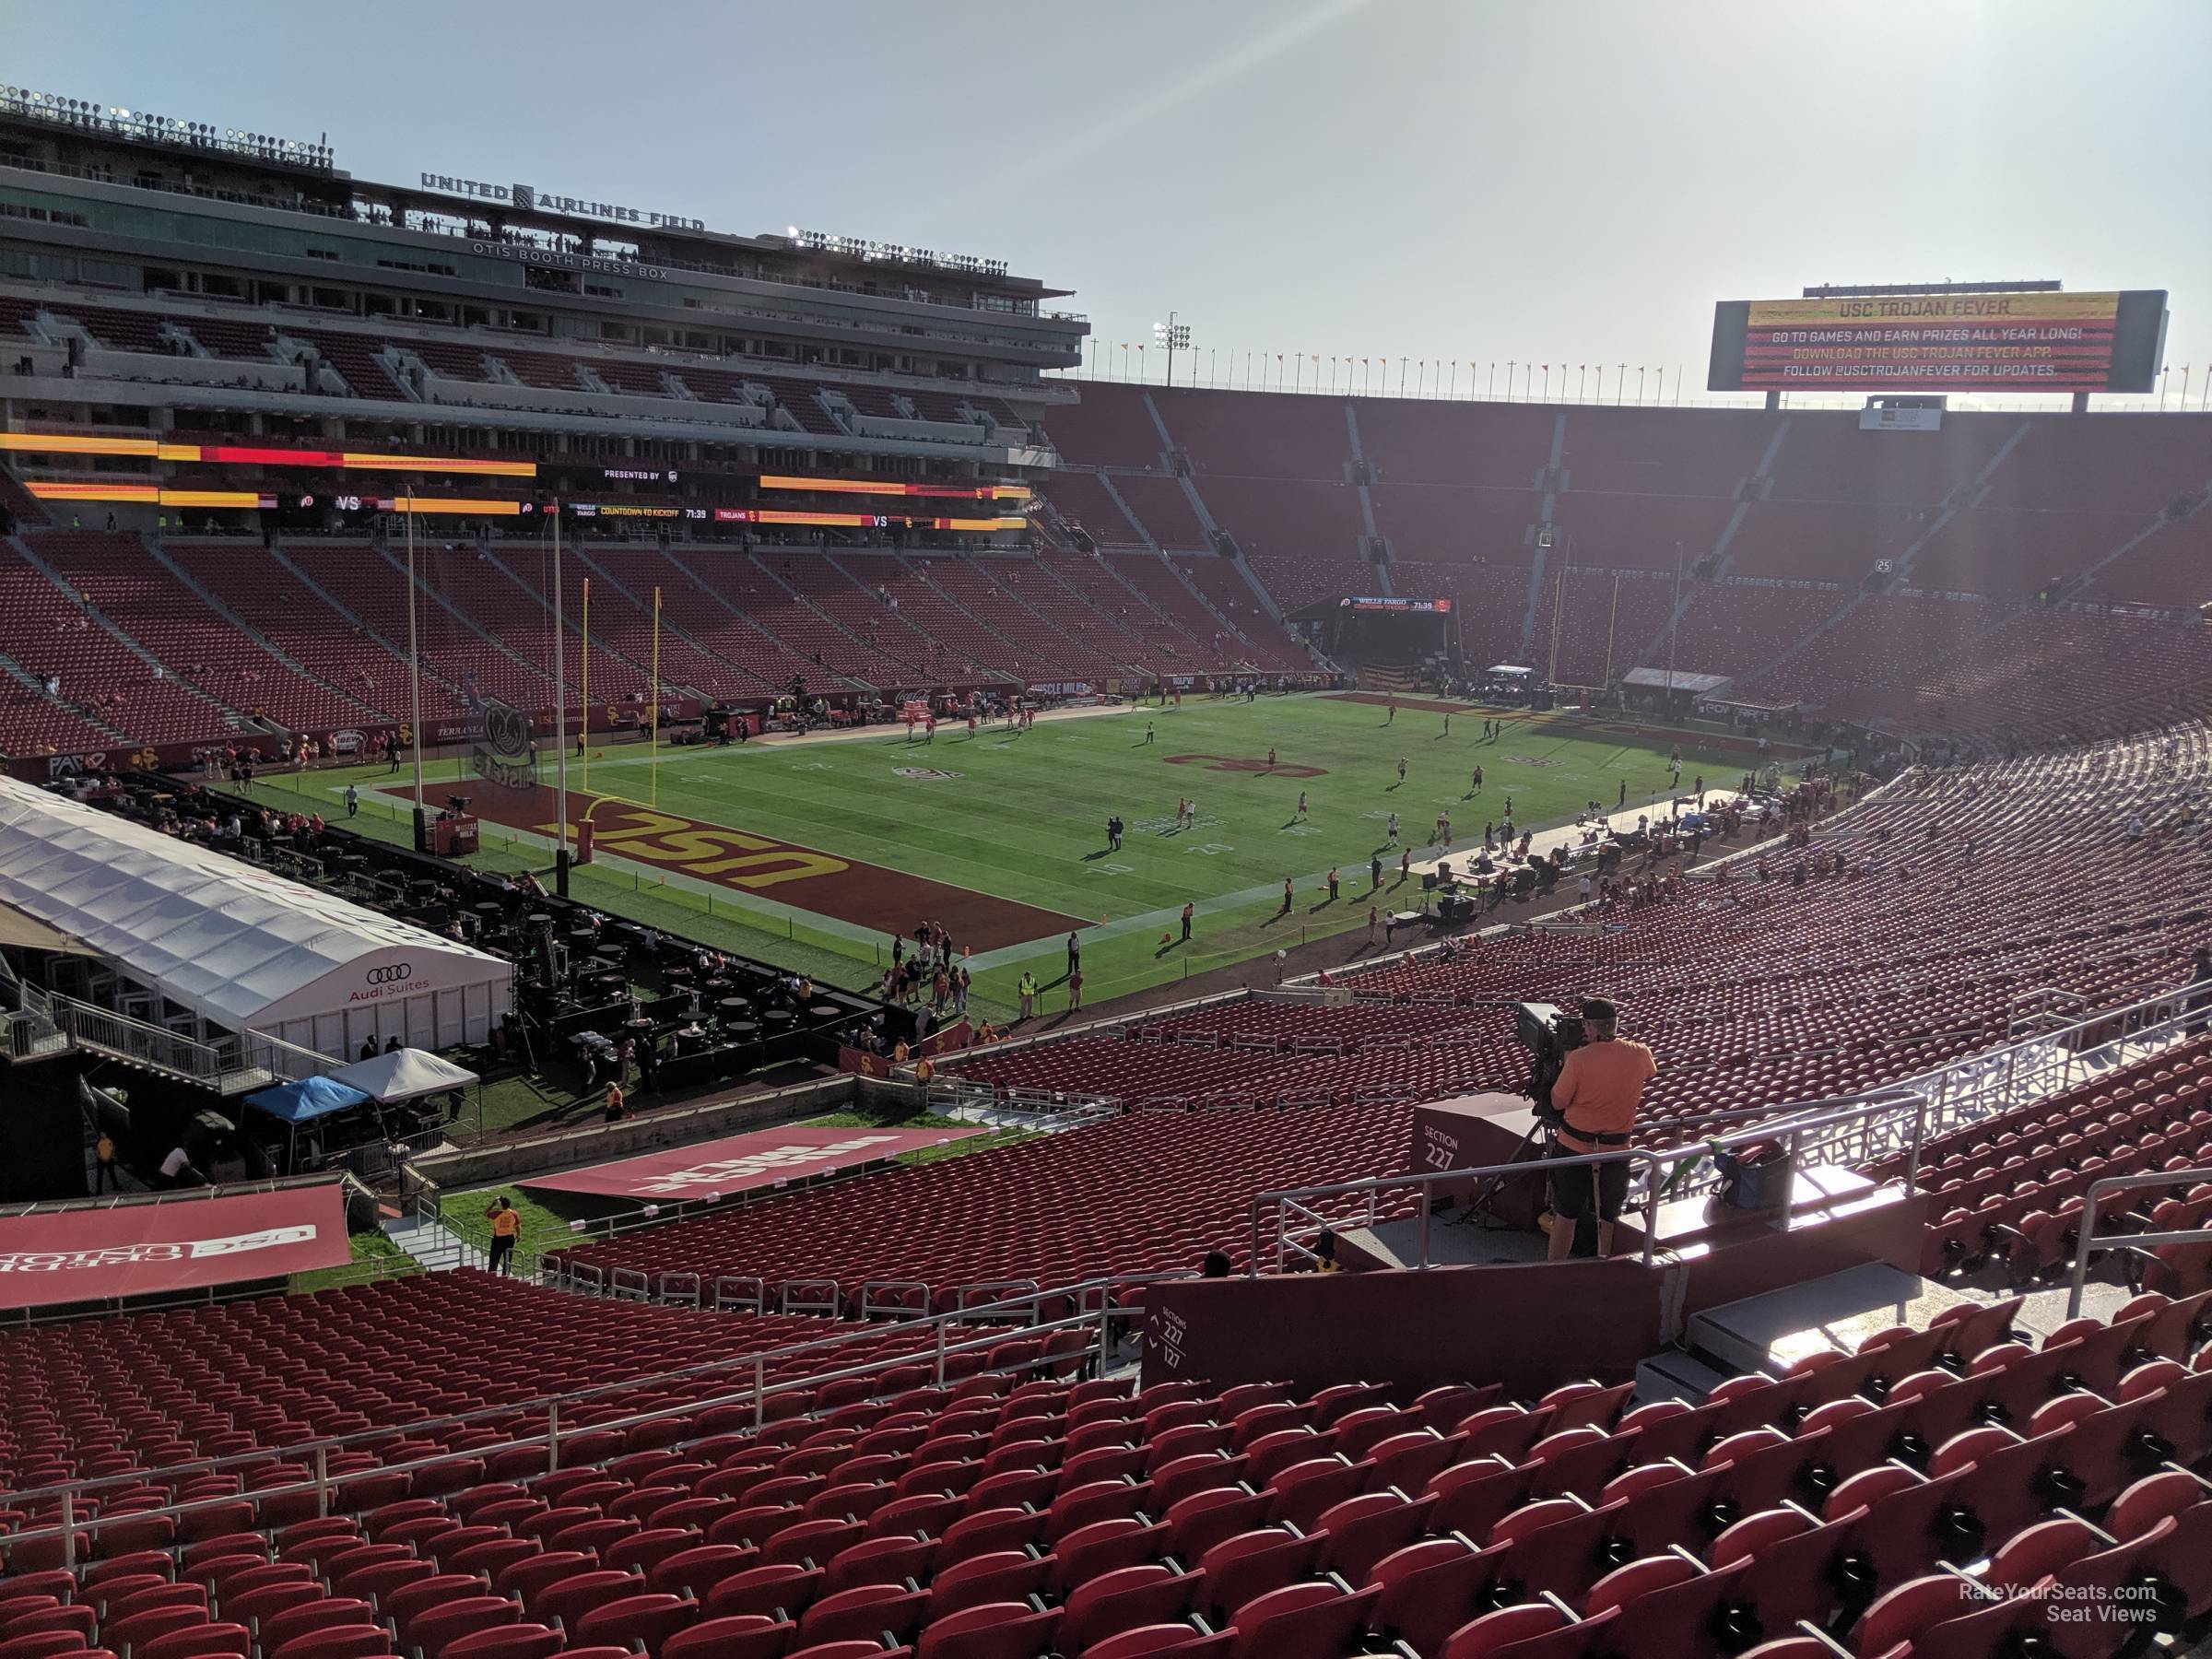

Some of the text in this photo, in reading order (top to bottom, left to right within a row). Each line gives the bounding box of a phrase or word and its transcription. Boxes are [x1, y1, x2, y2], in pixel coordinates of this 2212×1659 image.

[421, 172, 706, 232] UNITED AIRLINES FIELD
[473, 242, 668, 280] OTIS BOOTH PRESS BOX
[1840, 302, 1873, 318] USC
[1878, 301, 1947, 317] TROJAN
[1953, 300, 2011, 315] FEVER
[1771, 328, 2083, 343] GO TO GAMES AND EARN PRIZES ALL YEAR LONG!
[1793, 348, 1862, 359] DOWNLOAD
[1865, 347, 1888, 359] THE
[1892, 347, 1918, 359] USC
[1922, 347, 1974, 359] TROJAN
[1977, 347, 2020, 358] FEVER
[1783, 364, 2058, 377] FOLLOW @USCTROJANFEVER FOR UPDATES.
[605, 470, 648, 479] PRESENTED
[650, 472, 660, 480] BY
[338, 496, 359, 511] VS
[600, 507, 642, 516] COUNTDOWN
[653, 509, 679, 517] KICKOFF
[686, 509, 707, 519] 71:39
[720, 511, 746, 520] TROJANS
[873, 515, 888, 528] VS
[1877, 560, 1889, 571] 25
[1413, 602, 1433, 610] 71:39
[531, 812, 851, 889] USC
[348, 979, 430, 1003] Audi Suites
[1424, 1124, 1459, 1150] SECTION
[1425, 1143, 1454, 1171] 227
[196, 1229, 311, 1254] USC
[1163, 1306, 1187, 1330] SECTIONS
[1164, 1321, 1183, 1345] 227
[1164, 1345, 1181, 1369] 127
